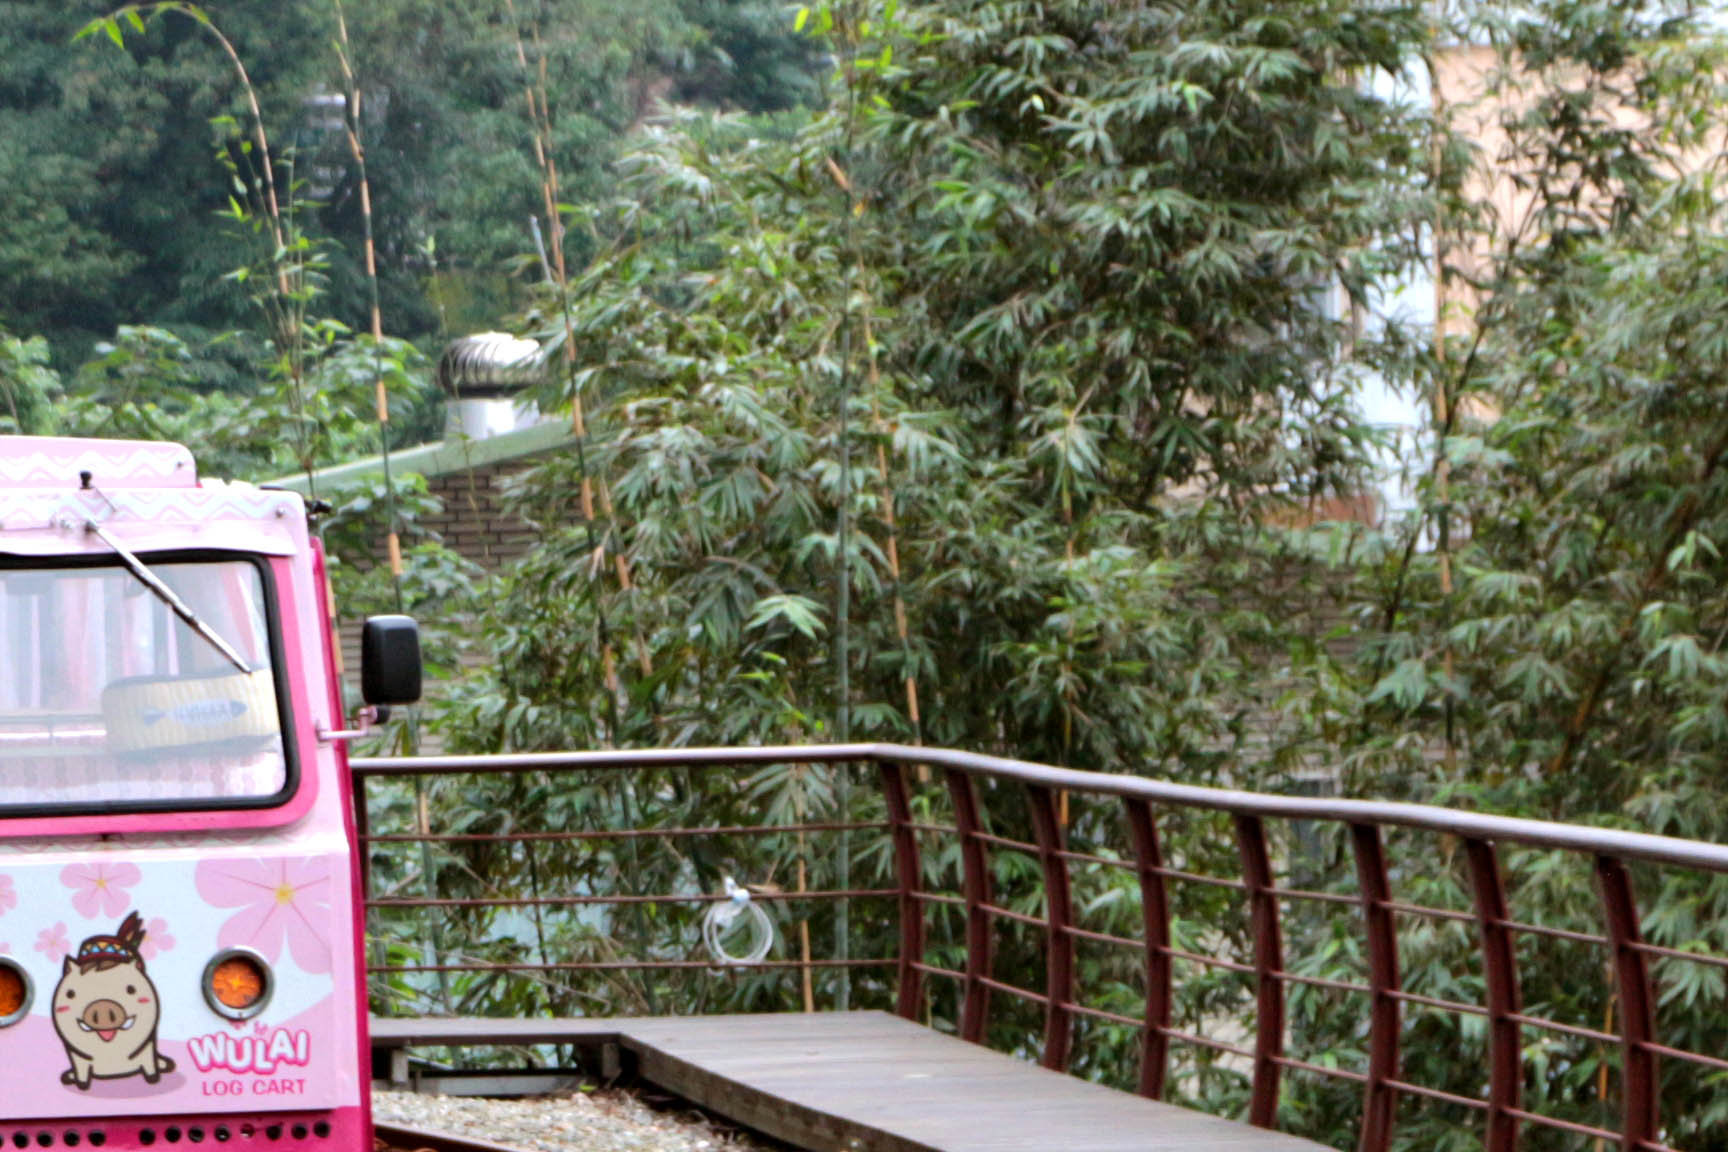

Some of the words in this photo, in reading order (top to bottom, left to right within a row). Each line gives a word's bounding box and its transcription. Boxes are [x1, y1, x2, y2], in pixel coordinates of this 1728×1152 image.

[187, 1028, 311, 1075] WULAI
[202, 1079, 244, 1096] LOG
[252, 1078, 308, 1096] CART
